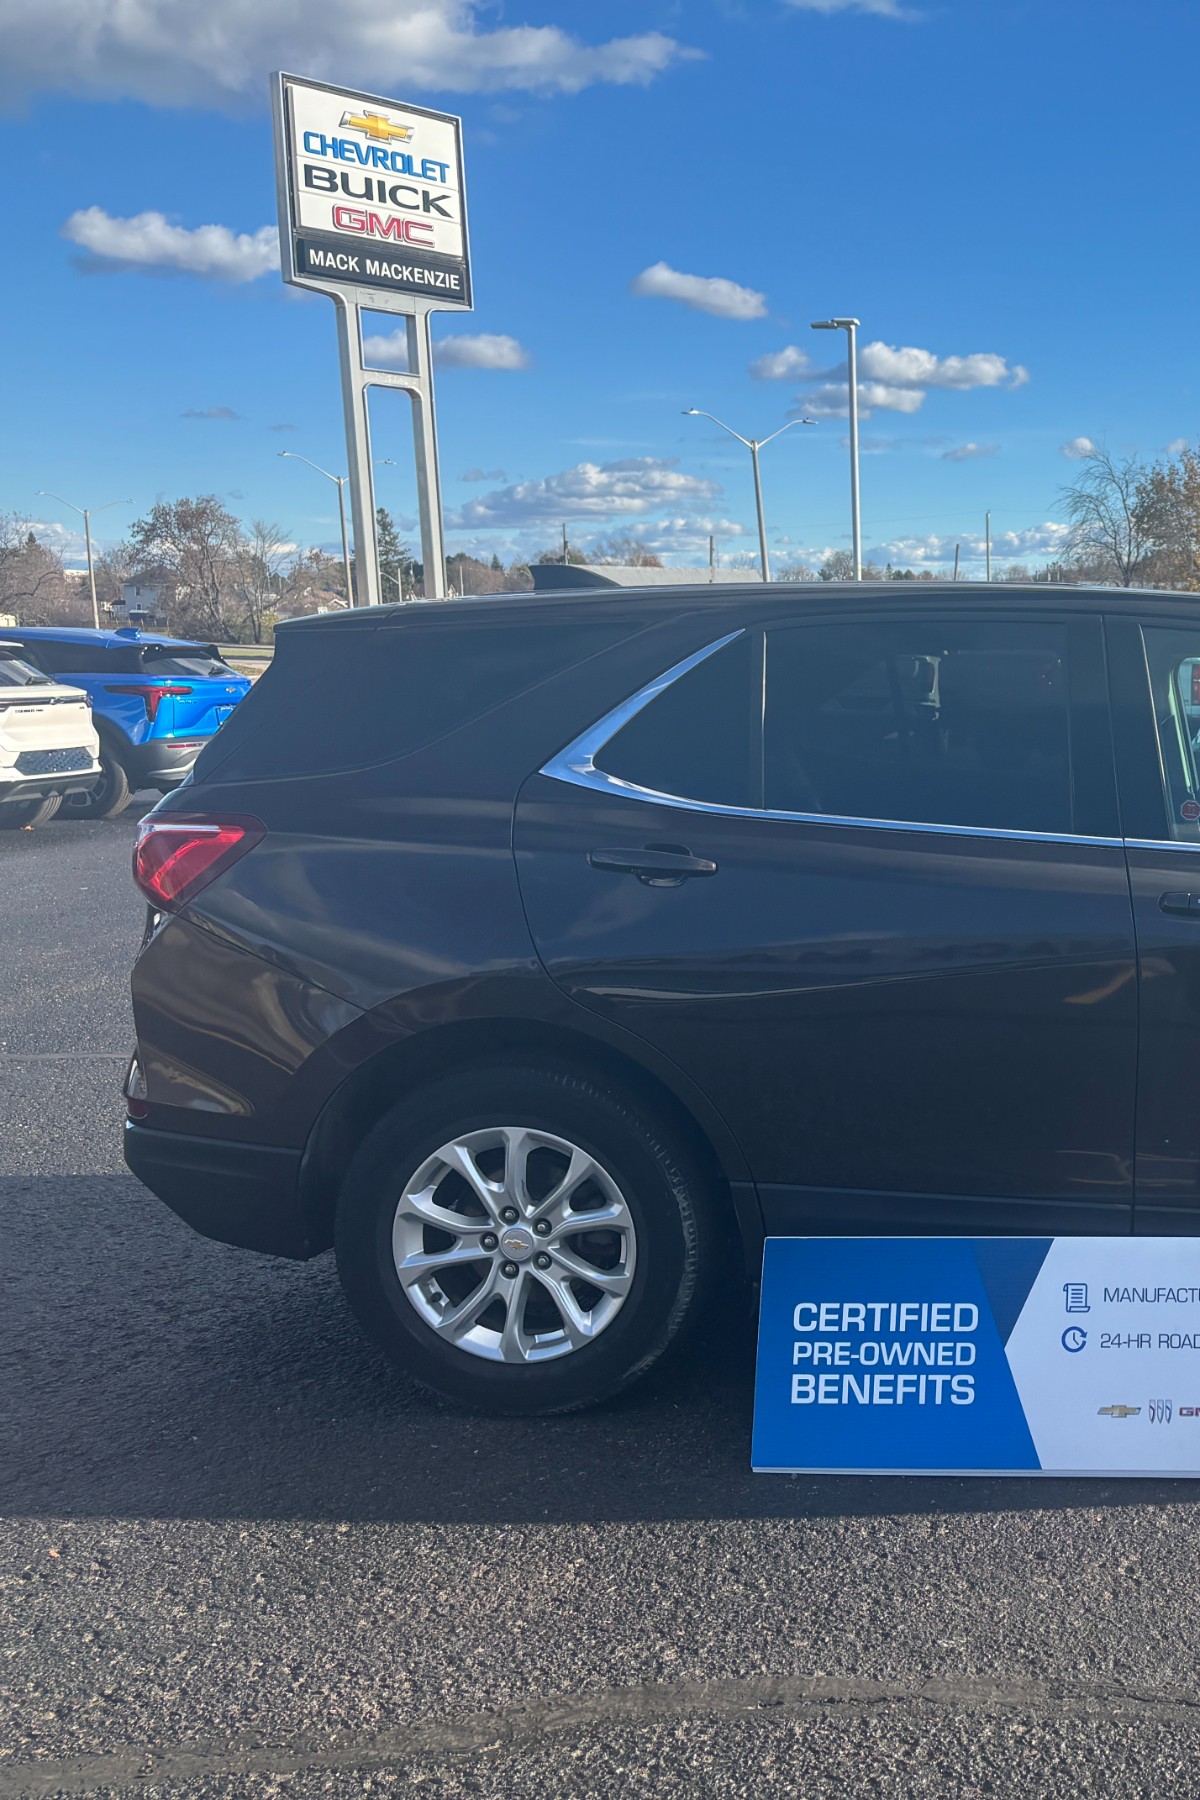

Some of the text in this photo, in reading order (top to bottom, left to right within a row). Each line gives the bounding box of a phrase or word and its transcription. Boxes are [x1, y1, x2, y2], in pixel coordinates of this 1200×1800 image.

[303, 131, 449, 183] CHEVROLET
[303, 164, 454, 218] BUICK
[332, 204, 435, 248] GMC
[309, 249, 460, 289] MACK MACKENZIE
[792, 1302, 979, 1332] CERTIFIED
[792, 1341, 977, 1366] PRE-OWNED
[1100, 1333, 1152, 1349] 24-HR
[790, 1374, 976, 1405] BENEFITS
